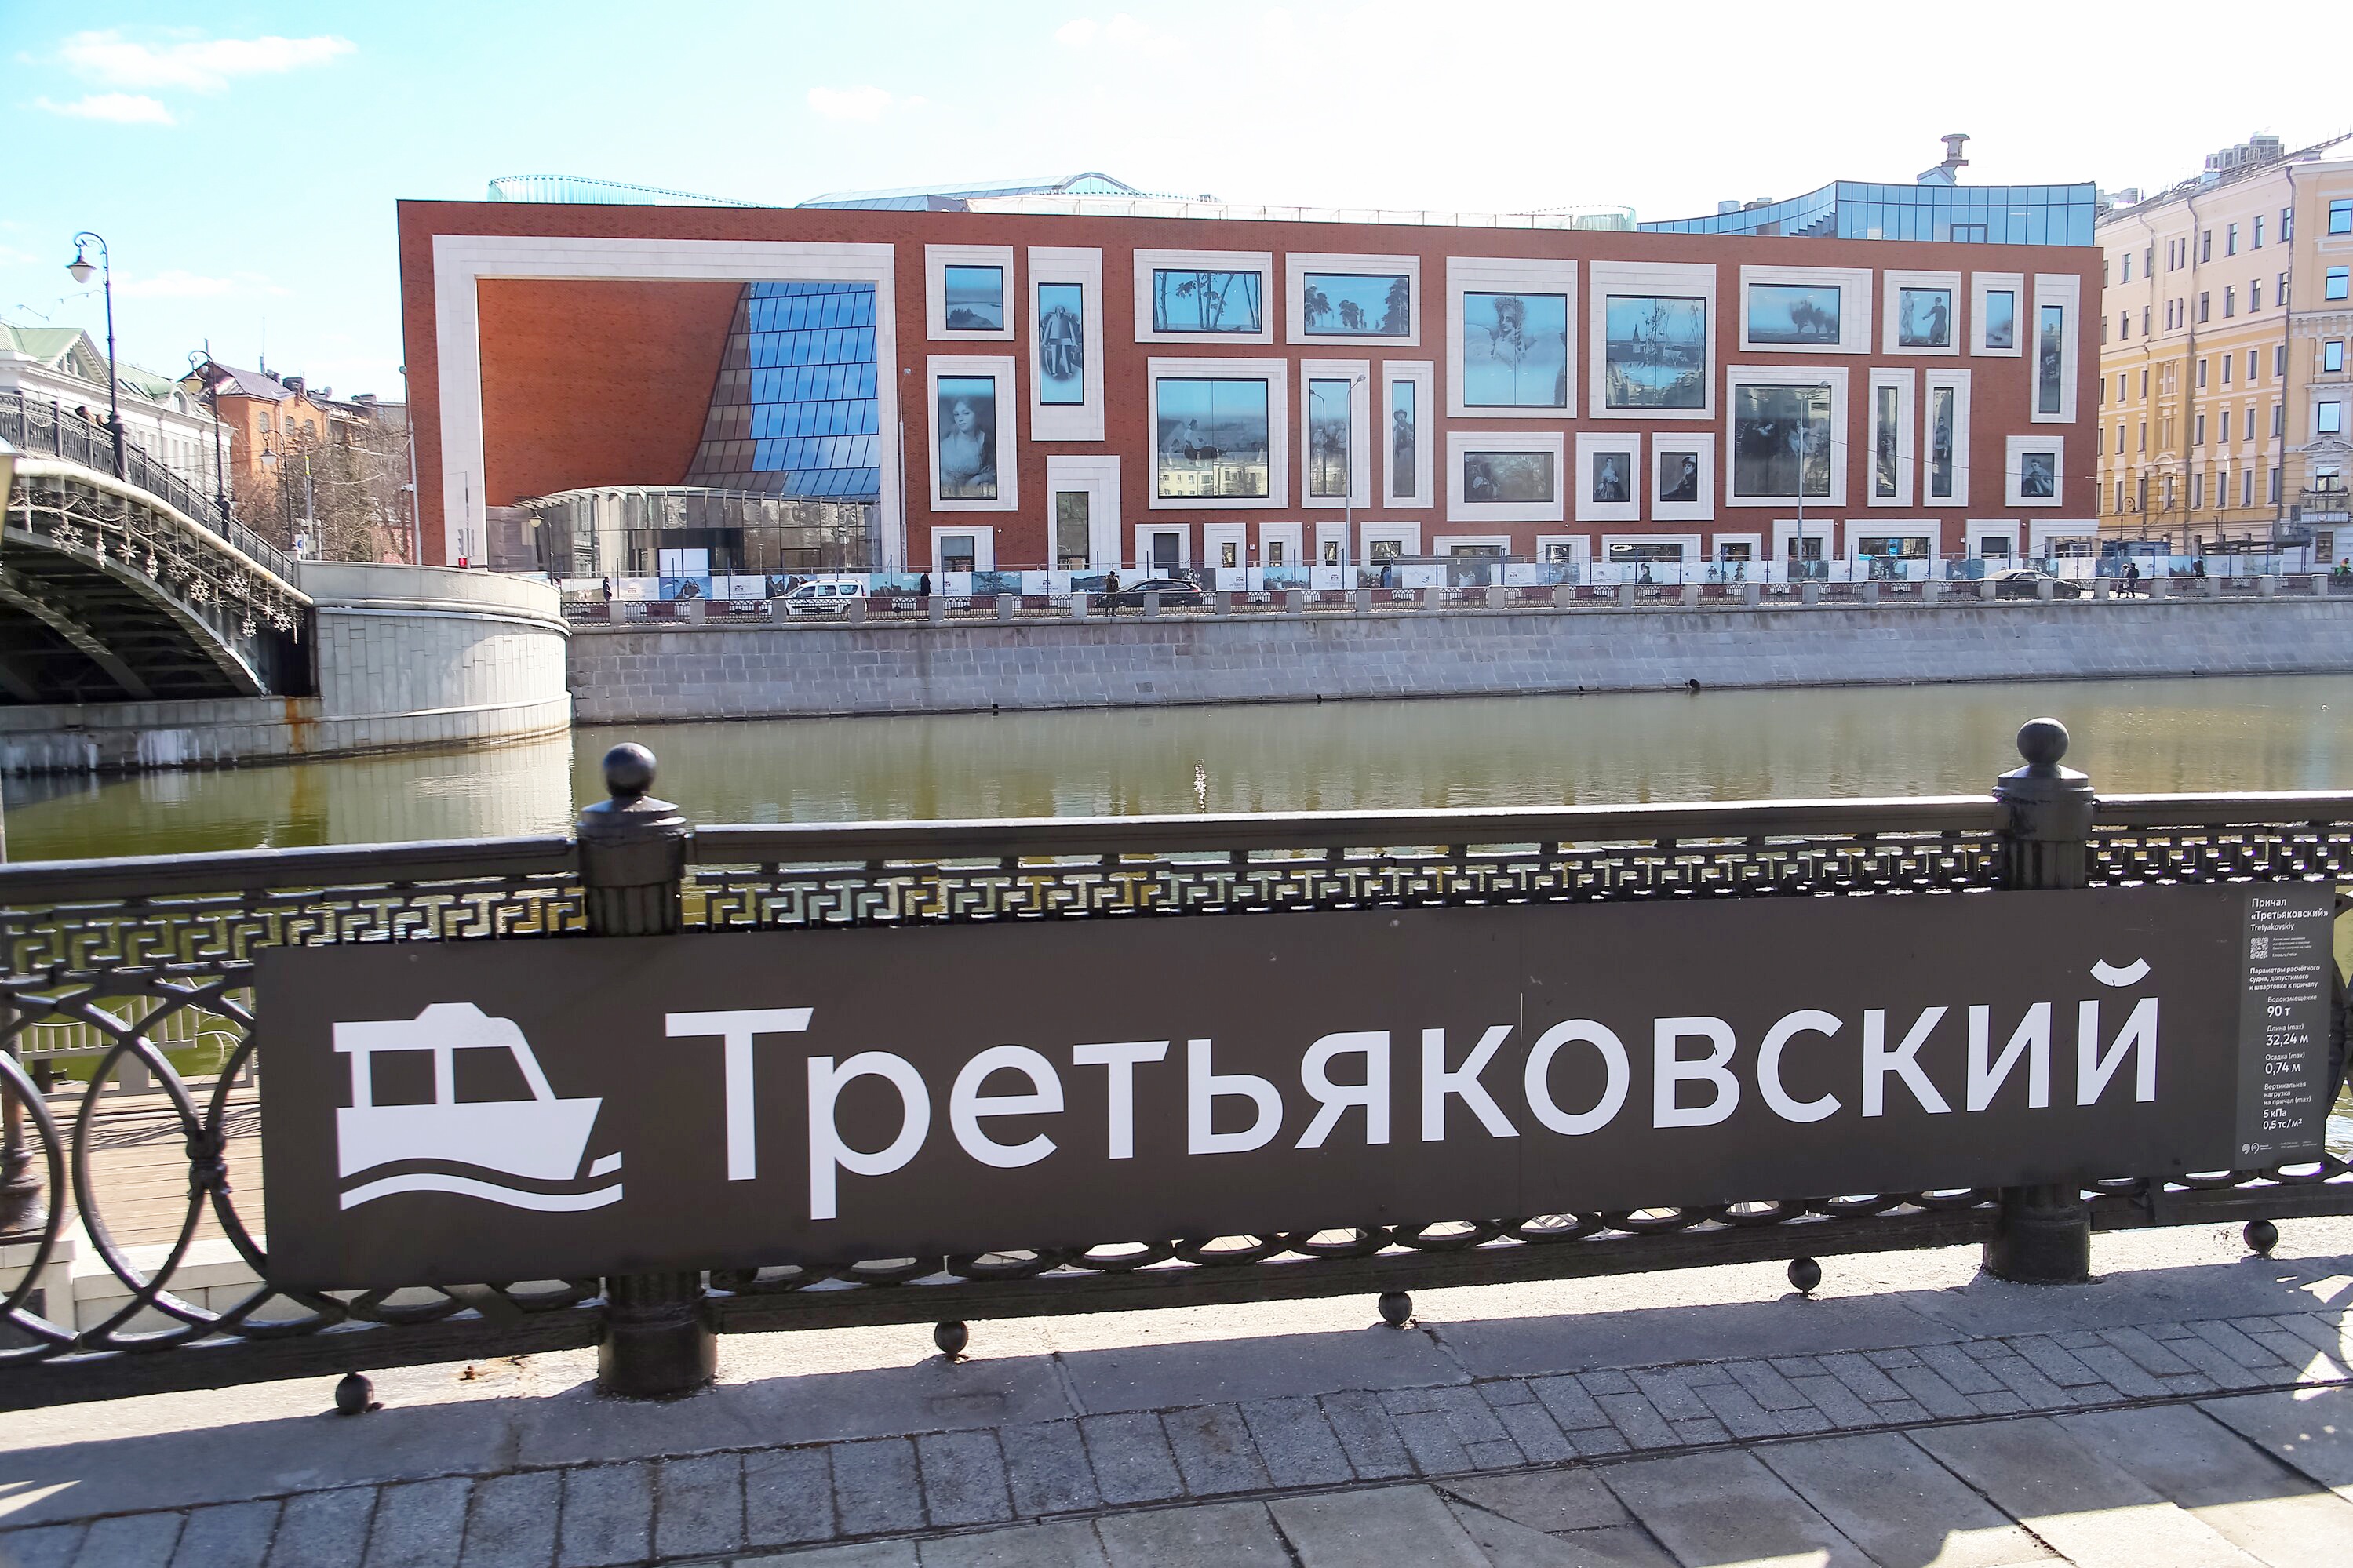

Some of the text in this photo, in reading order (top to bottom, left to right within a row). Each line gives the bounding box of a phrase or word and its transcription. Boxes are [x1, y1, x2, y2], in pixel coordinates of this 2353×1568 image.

[2251, 898, 2287, 909] Причал
[2250, 908, 2329, 921] «Третьяковский»
[2250, 922, 2295, 932] Tretyakovskiy
[2249, 965, 2320, 975] Параметры расчётного
[2270, 973, 2309, 982] допустимого
[2254, 983, 2287, 991] швартовке
[2293, 981, 2318, 990] причалу
[2267, 995, 2318, 1003] Водоизмещение
[2267, 1005, 2291, 1017] 90 т
[2267, 1024, 2286, 1033] Длина
[2266, 1033, 2297, 1048] 32,24
[2265, 1062, 2289, 1076] 0,74
[665, 958, 2160, 1219] Третьяковский
[2264, 1082, 2307, 1091] Вертикальная
[2263, 1108, 2287, 1119] 5 кПа
[2263, 1120, 2276, 1130] 0,5
